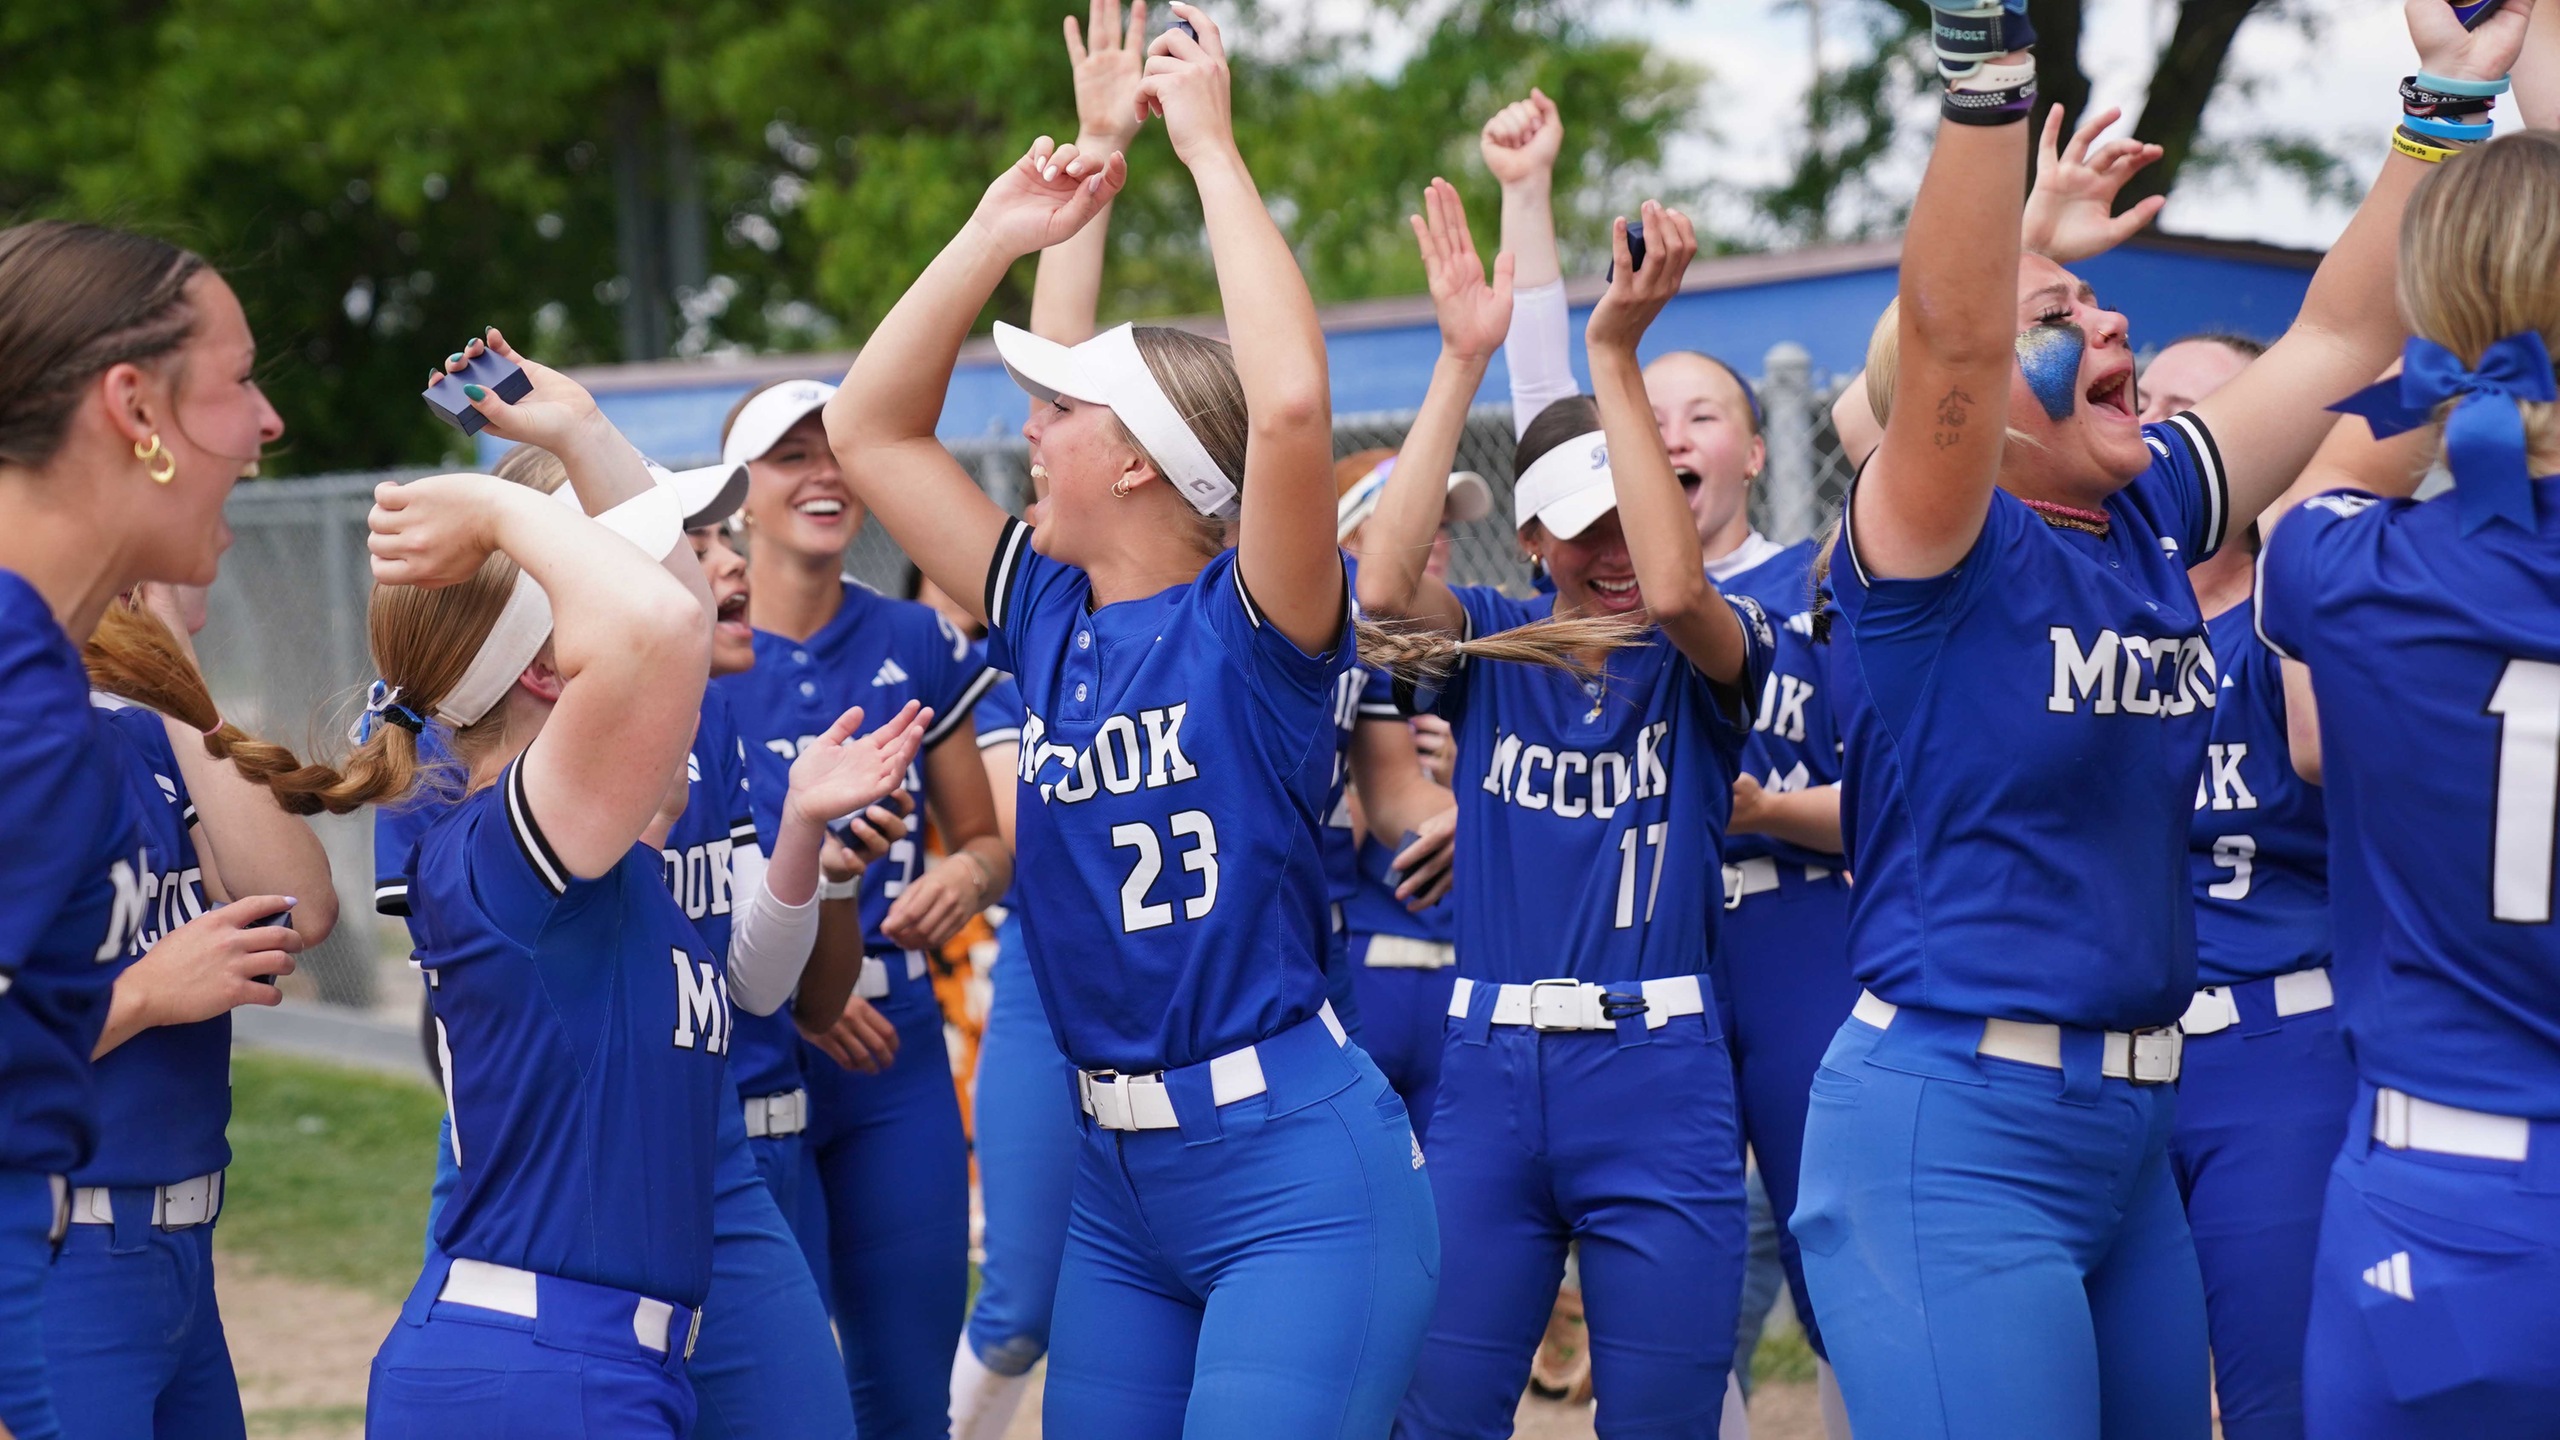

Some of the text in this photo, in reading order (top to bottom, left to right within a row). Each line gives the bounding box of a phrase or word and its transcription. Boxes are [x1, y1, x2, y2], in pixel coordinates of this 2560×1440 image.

[1955, 30, 1987, 41] BOLT
[2400, 84, 2417, 100] Alex
[2416, 147, 2426, 156] Do
[1111, 809, 1219, 934] 23
[1614, 820, 1669, 929] 17
[2208, 833, 2257, 901] 9
